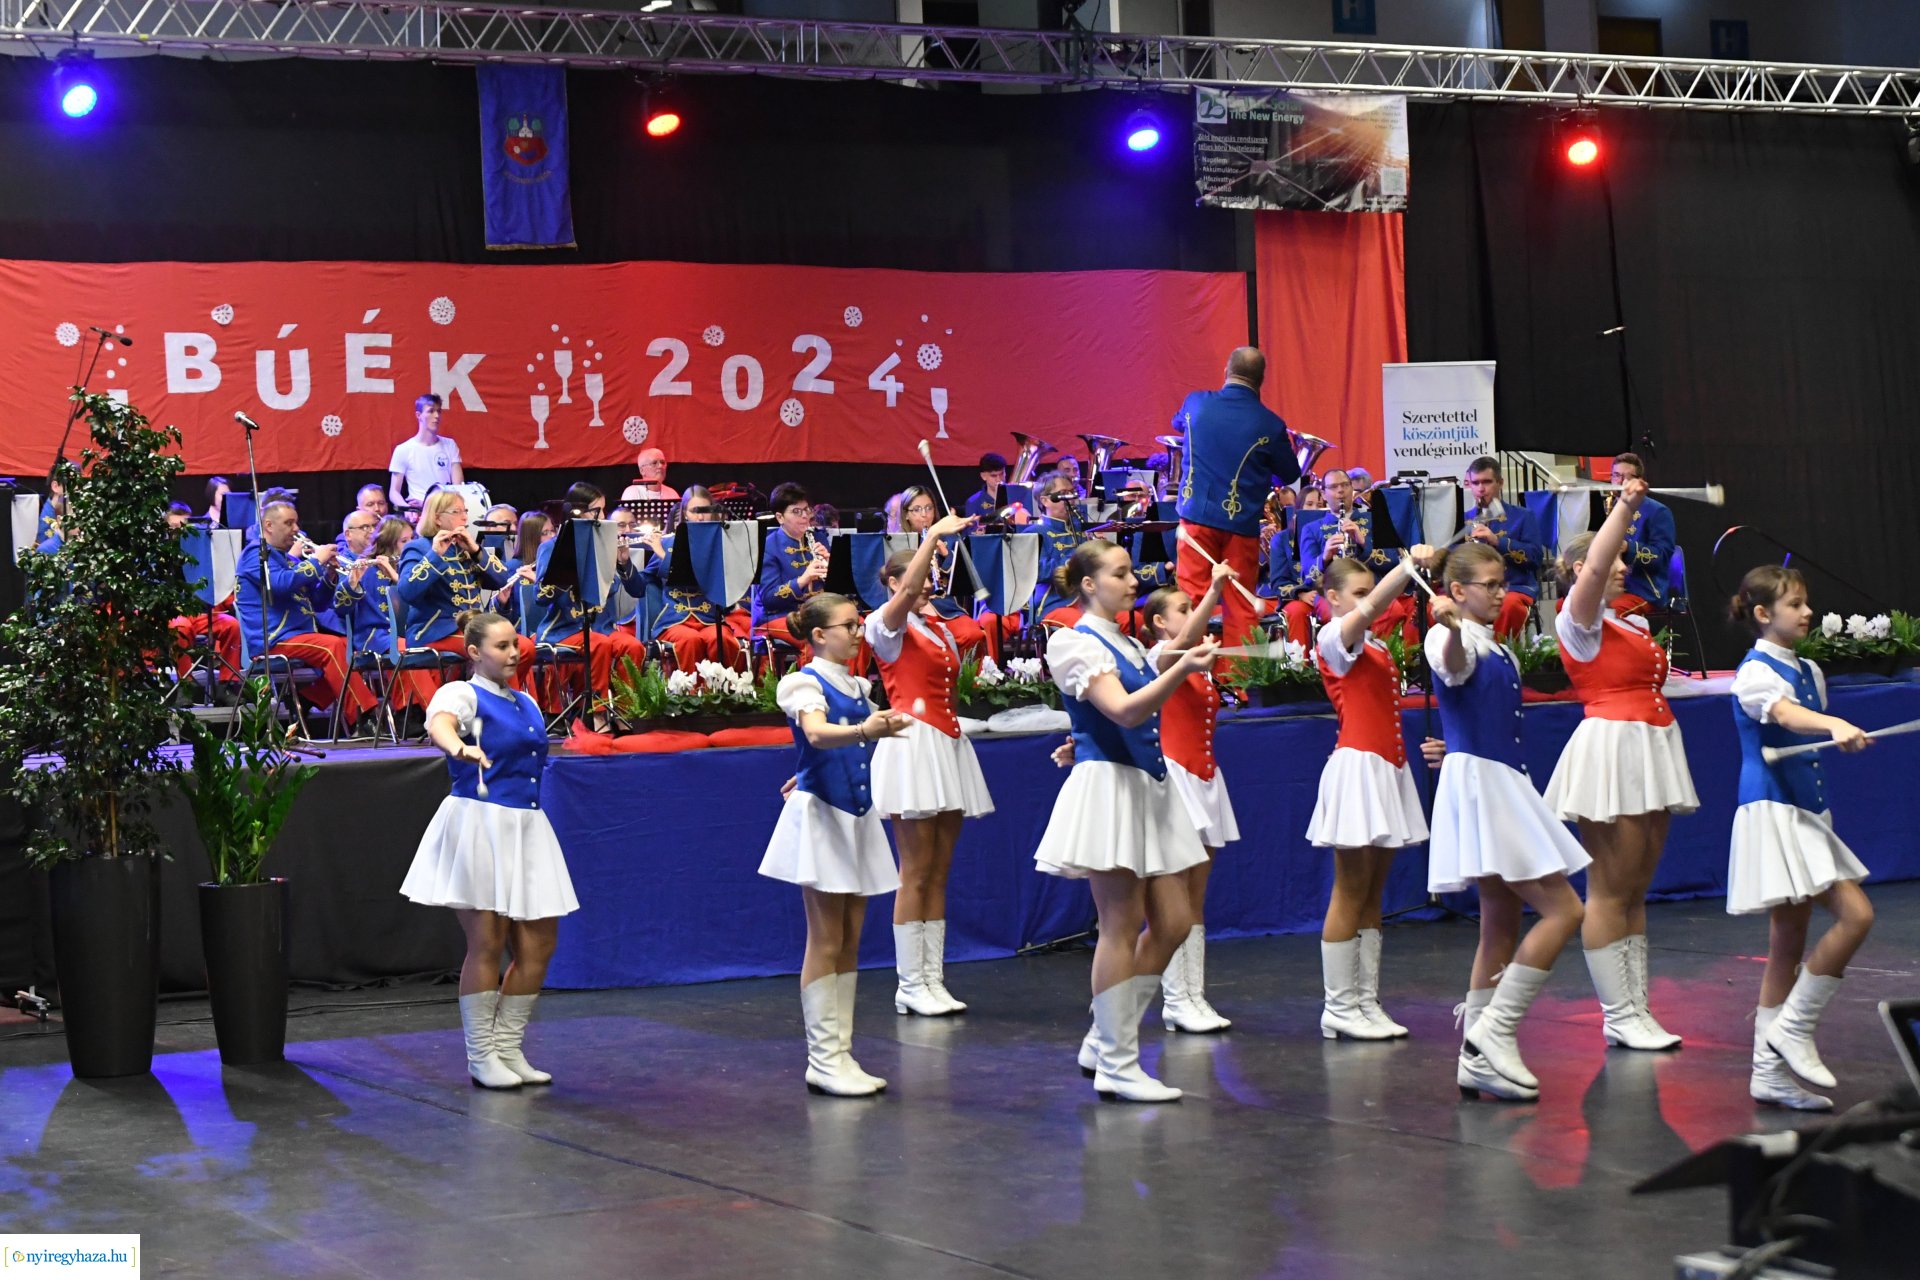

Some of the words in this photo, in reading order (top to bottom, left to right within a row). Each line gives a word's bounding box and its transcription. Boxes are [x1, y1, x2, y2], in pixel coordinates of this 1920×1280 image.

[1230, 110, 1247, 120] The
[1249, 111, 1270, 121] New
[1272, 112, 1305, 124] Energy
[646, 334, 904, 411] 2024
[1402, 409, 1478, 424] Szeretettel
[1402, 425, 1480, 442] köszöntjük
[1393, 442, 1489, 459] vendégeinket!
